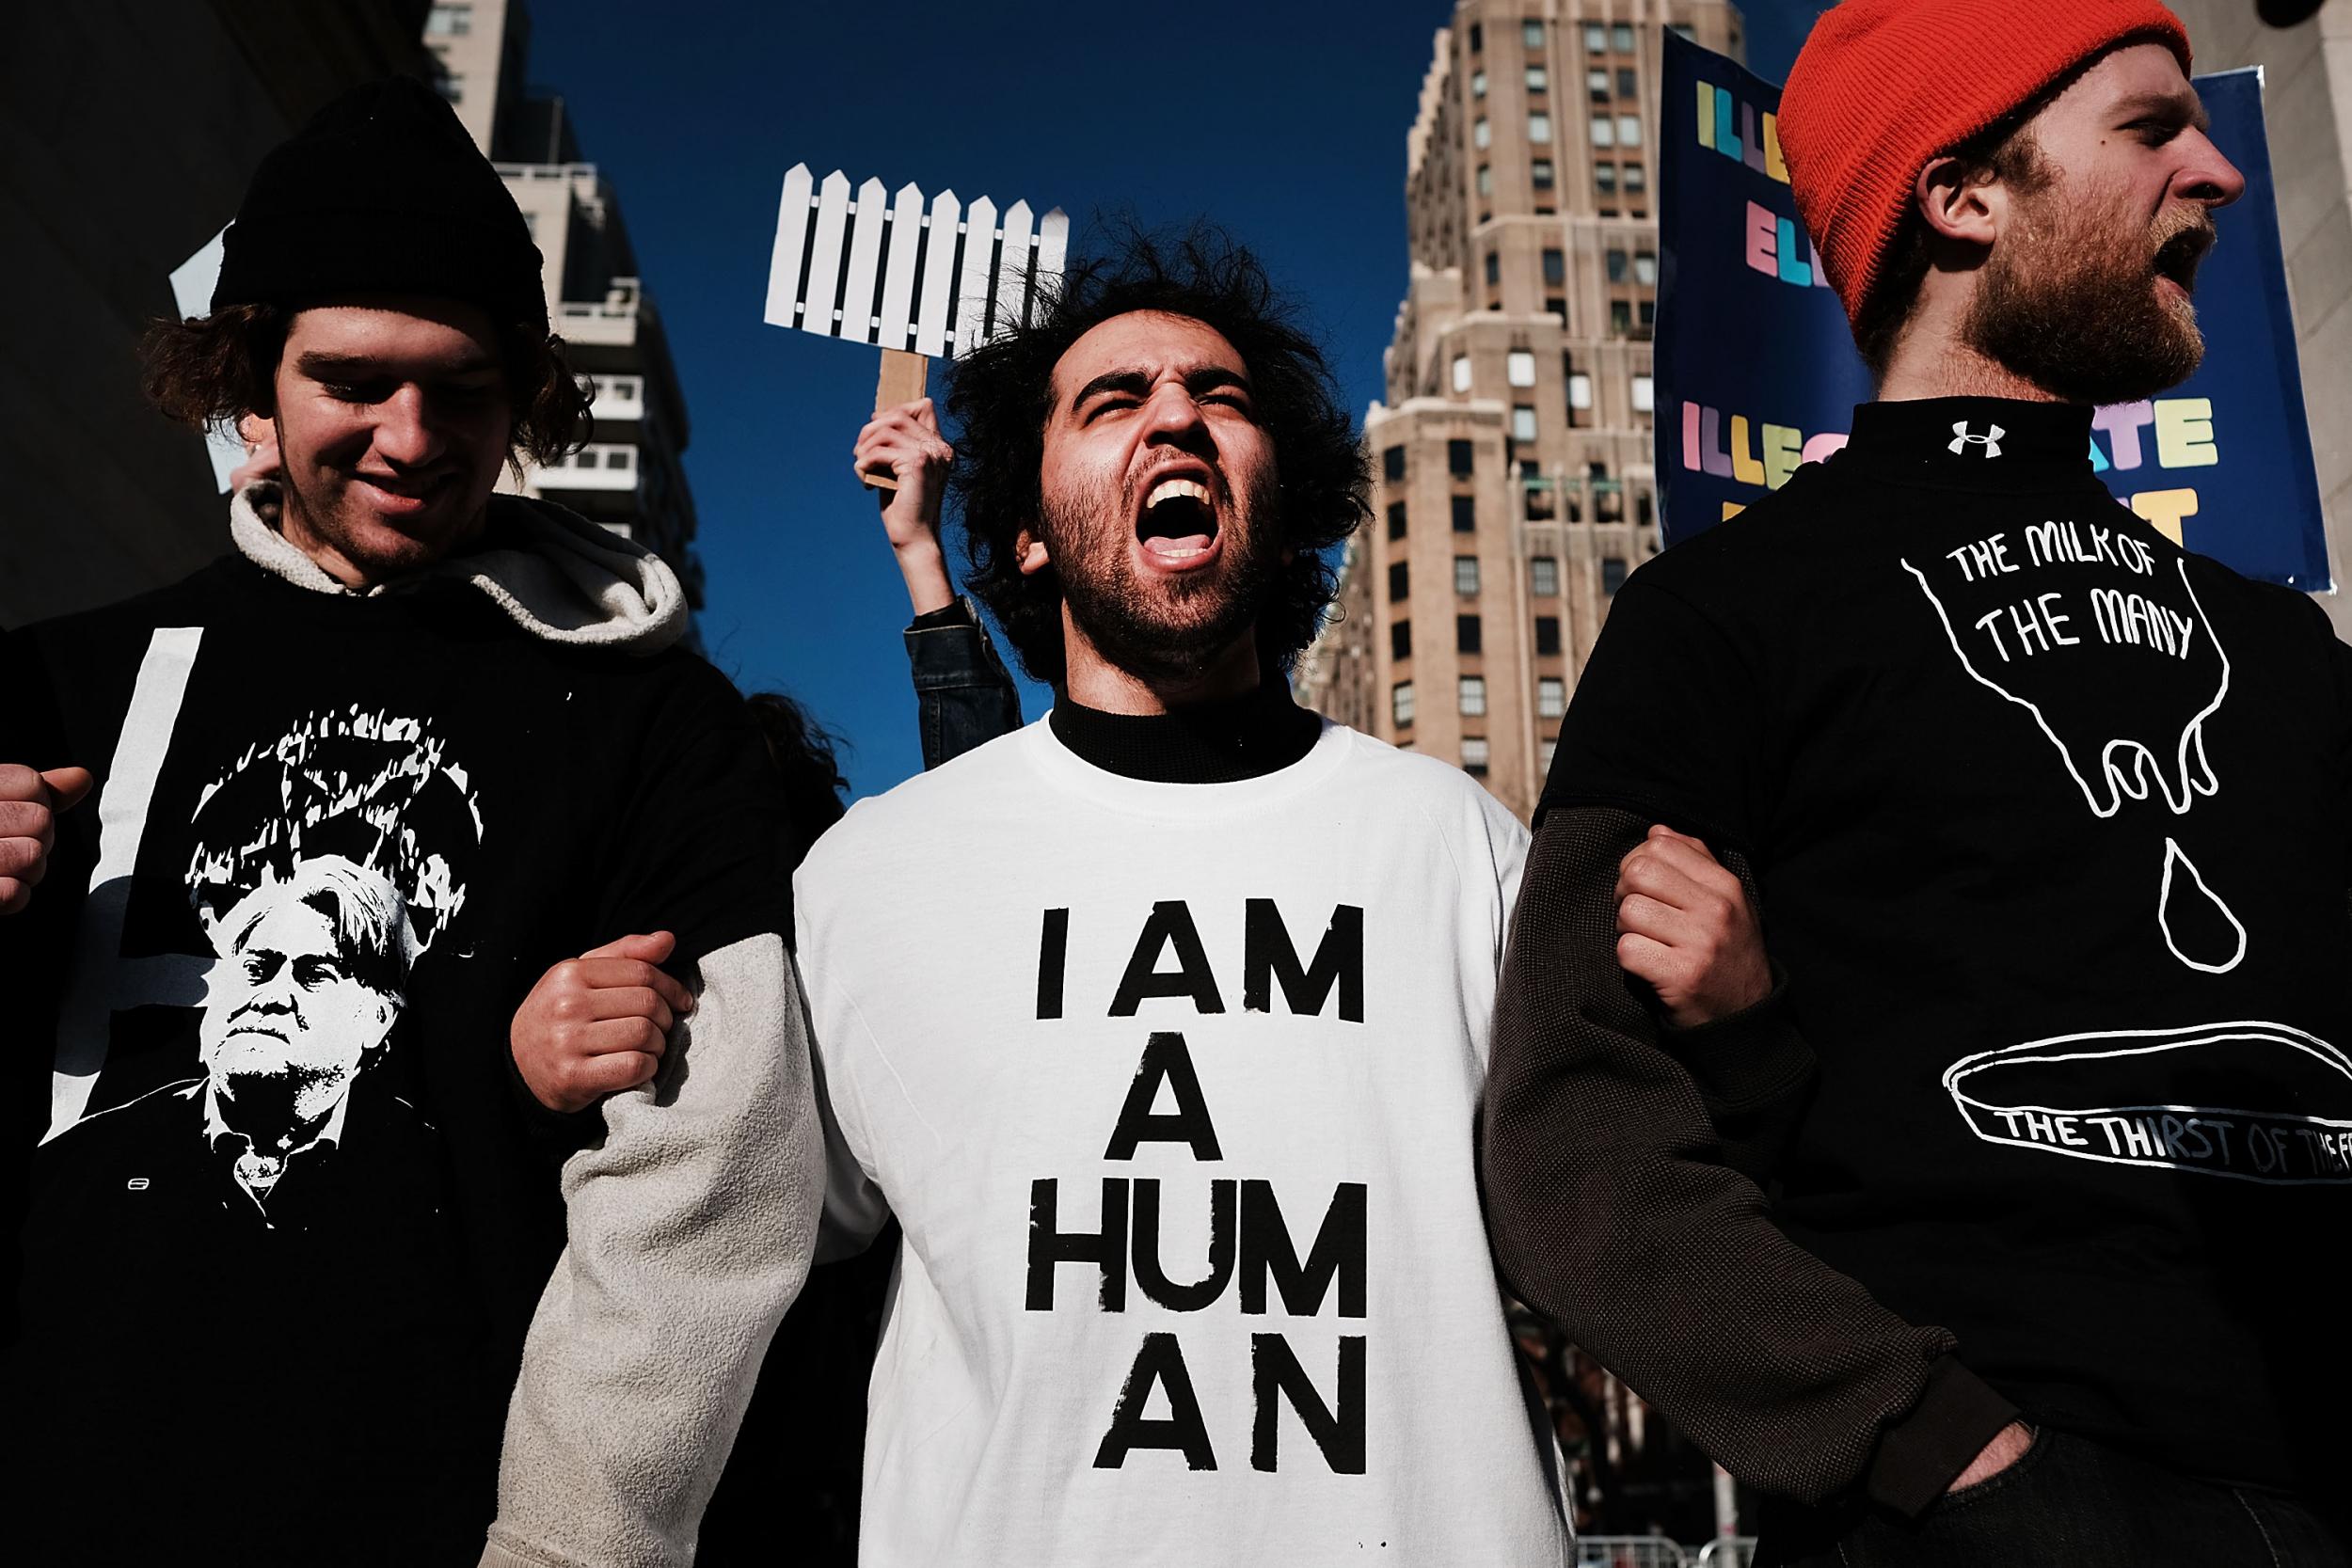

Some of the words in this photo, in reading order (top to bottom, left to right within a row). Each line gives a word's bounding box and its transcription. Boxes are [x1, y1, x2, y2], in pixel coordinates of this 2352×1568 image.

[1946, 533, 2021, 582] THE
[2025, 521, 2120, 567] MILK
[2118, 533, 2155, 577] OF
[1975, 593, 2080, 662] THE
[2090, 588, 2193, 660] MANY
[1036, 907, 1070, 1021] I
[1107, 897, 1364, 1024] AM
[1103, 1031, 1224, 1162] A
[1993, 1110, 2090, 1147] THE
[2084, 1115, 2235, 1165] THIRST
[2247, 1121, 2288, 1174] OF
[2293, 1128, 2344, 1174] THE
[1025, 1177, 1368, 1319] HUM
[1092, 1332, 1367, 1475] AN
